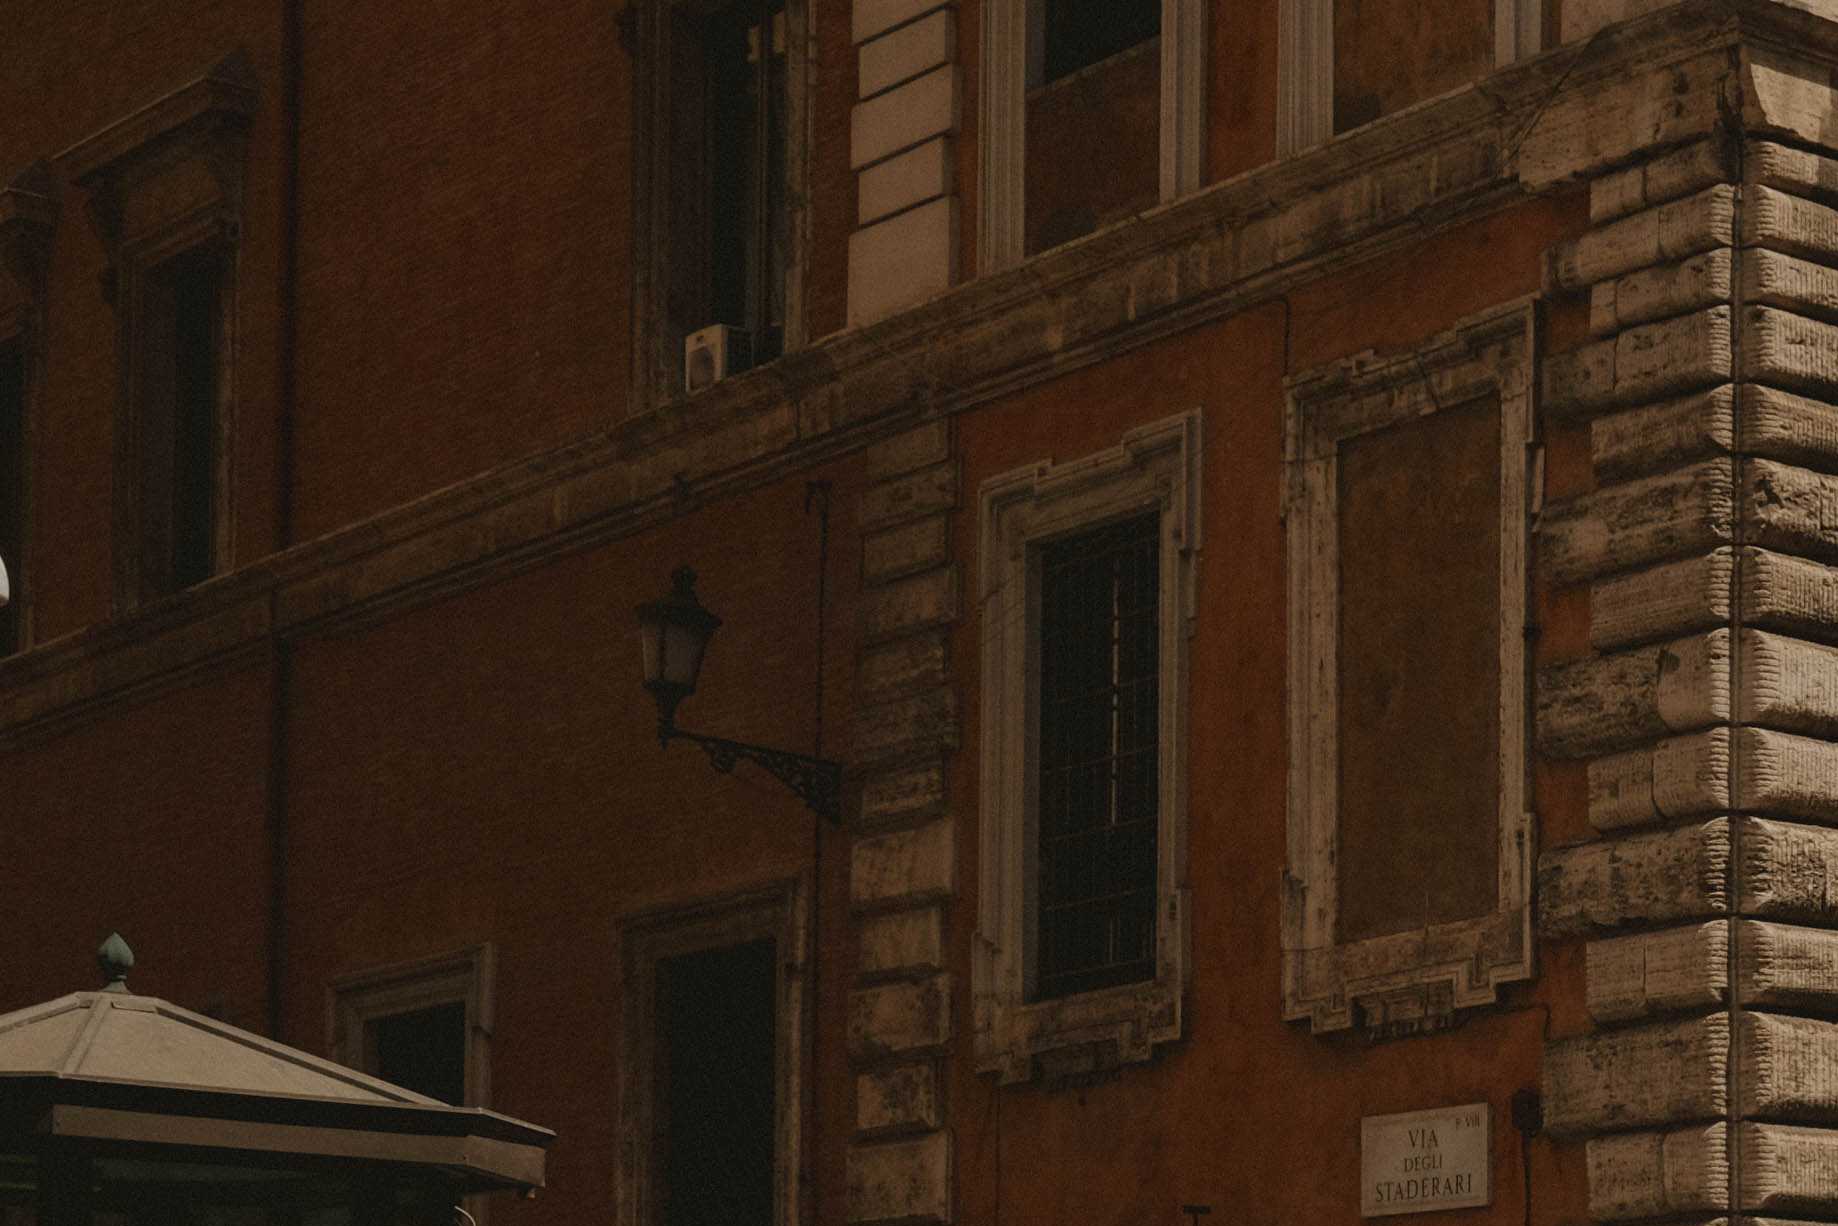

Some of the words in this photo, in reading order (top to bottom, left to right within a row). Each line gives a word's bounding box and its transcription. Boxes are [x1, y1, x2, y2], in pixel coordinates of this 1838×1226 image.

[1408, 1128, 1439, 1149] VIA
[1403, 1154, 1442, 1173] DEGLI
[1375, 1173, 1472, 1202] STADERARI
